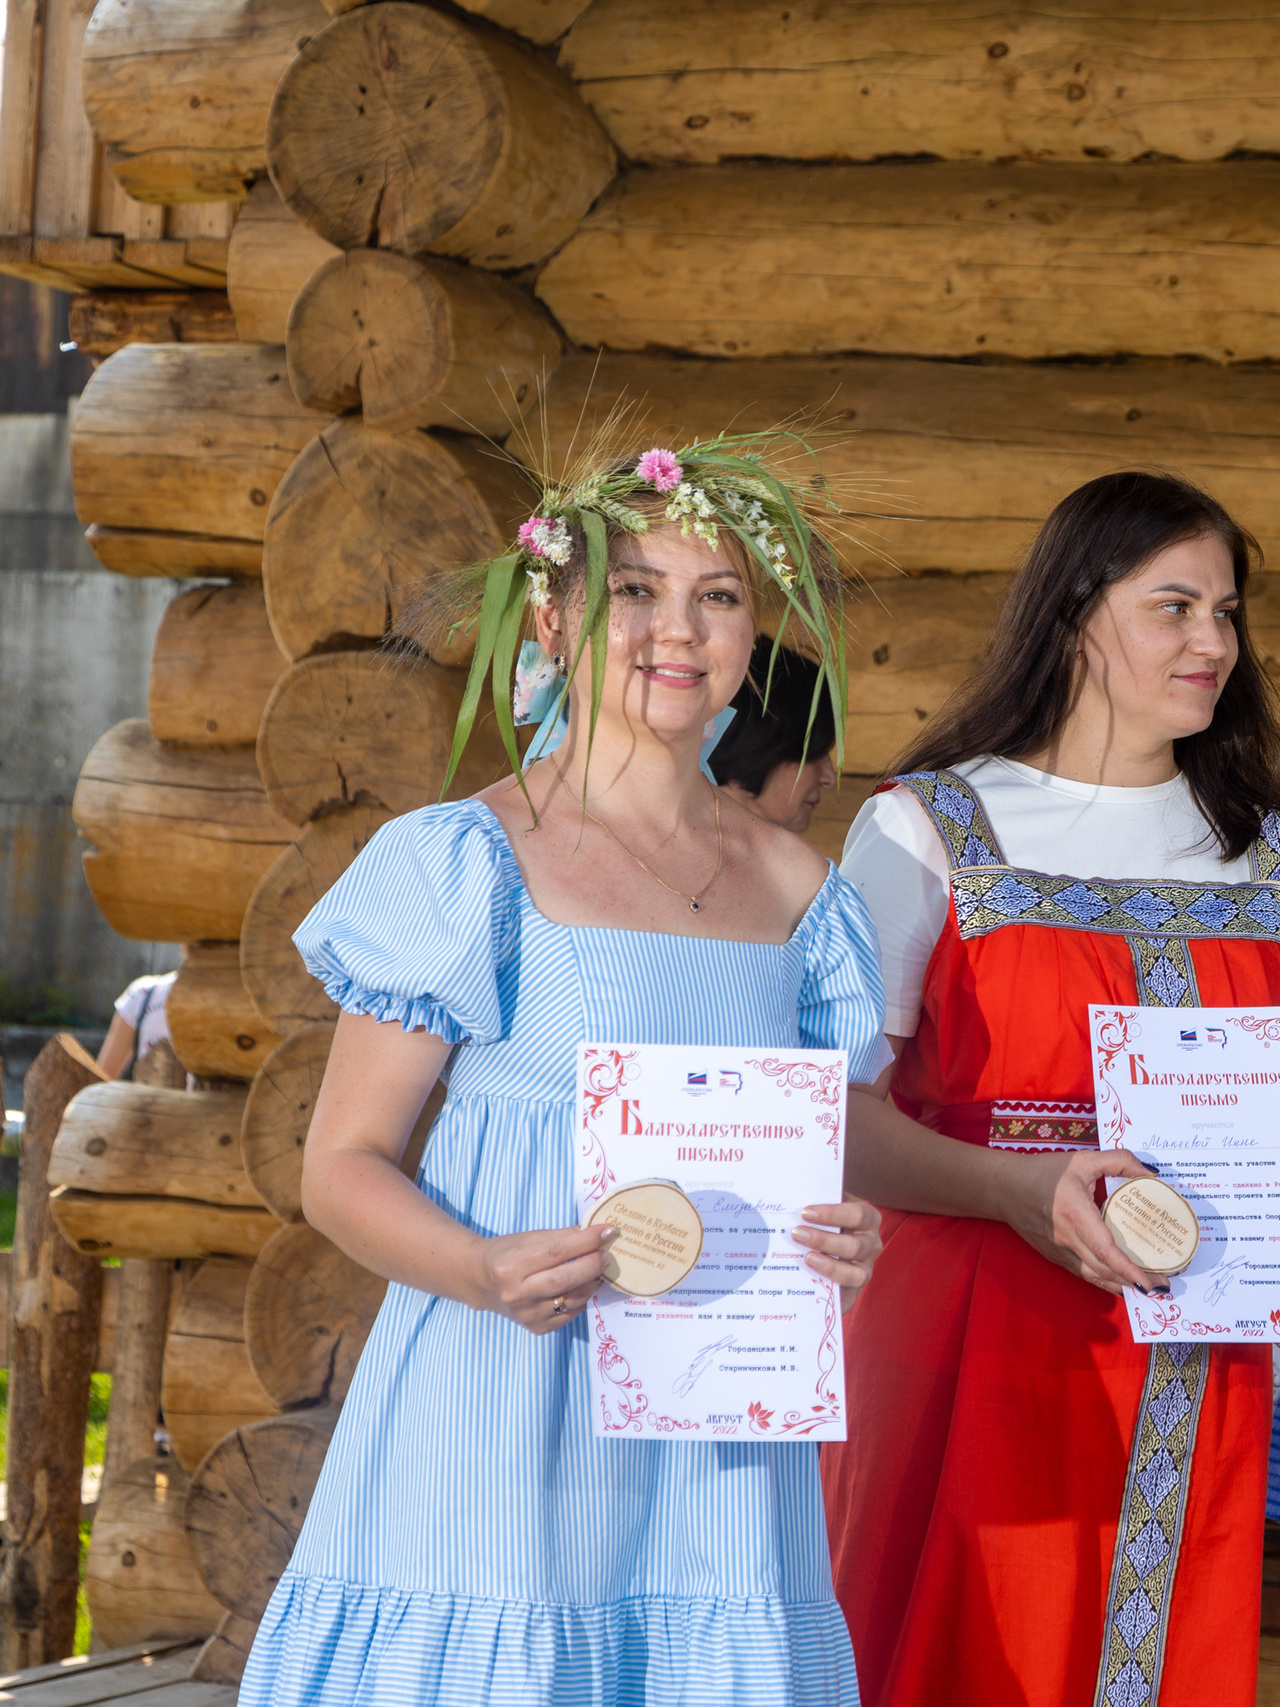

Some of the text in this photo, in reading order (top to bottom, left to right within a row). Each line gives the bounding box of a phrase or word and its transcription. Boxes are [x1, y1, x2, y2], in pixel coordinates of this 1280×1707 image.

[1176, 1160, 1230, 1168] благодарность
[613, 1202, 646, 1223] Сделано
[652, 1217, 688, 1239] Кузбассе
[1120, 1194, 1152, 1221] Сделано
[1158, 1223, 1184, 1246] России
[1129, 1187, 1156, 1210] Сделано
[1160, 1210, 1189, 1236] Кузбассе
[644, 1232, 651, 1240] в
[652, 1233, 685, 1253] России
[667, 1288, 754, 1296] редпринимательства
[719, 1365, 776, 1373] Старинчикова
